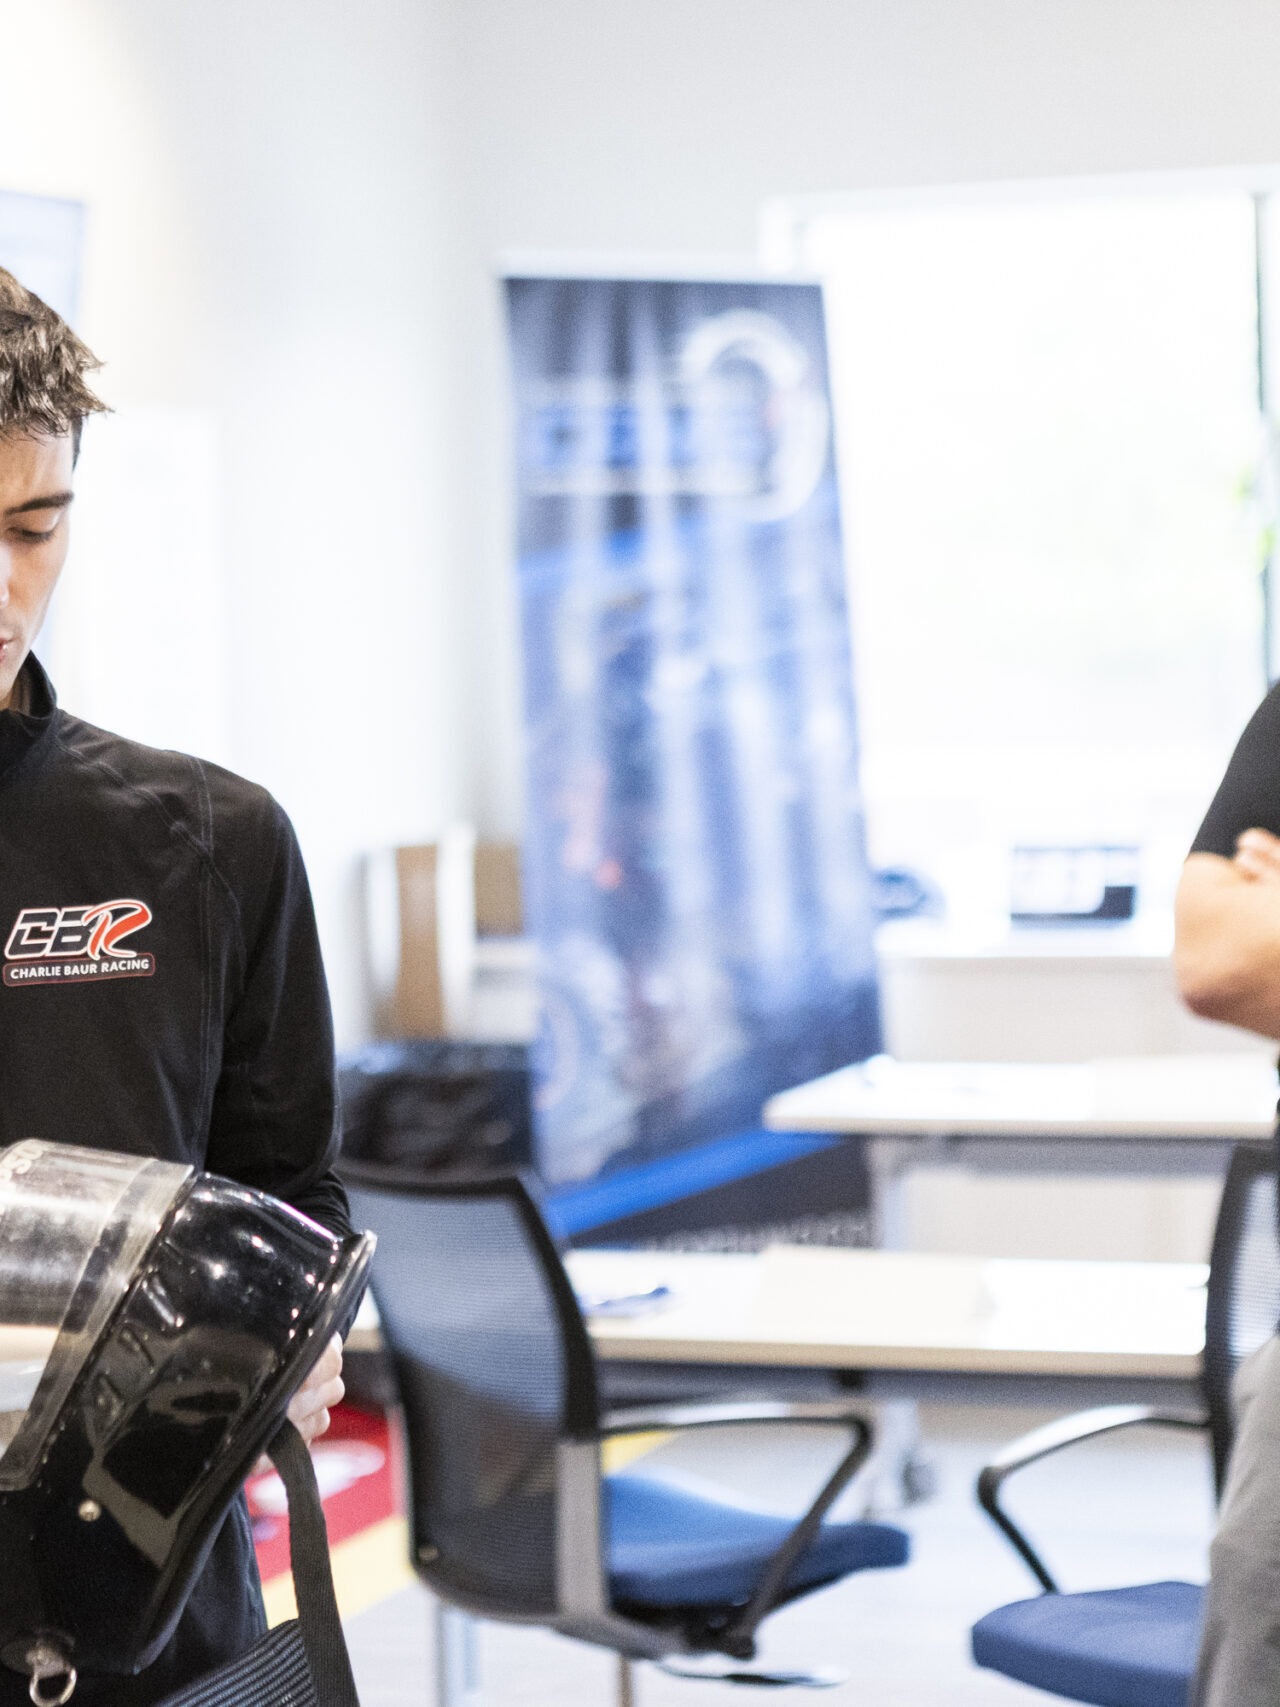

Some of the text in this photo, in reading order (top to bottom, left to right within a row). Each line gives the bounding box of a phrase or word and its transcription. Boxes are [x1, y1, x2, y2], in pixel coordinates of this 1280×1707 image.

[4, 899, 152, 961] CBR
[10, 959, 150, 980] CHARLIE BAUR RACING
